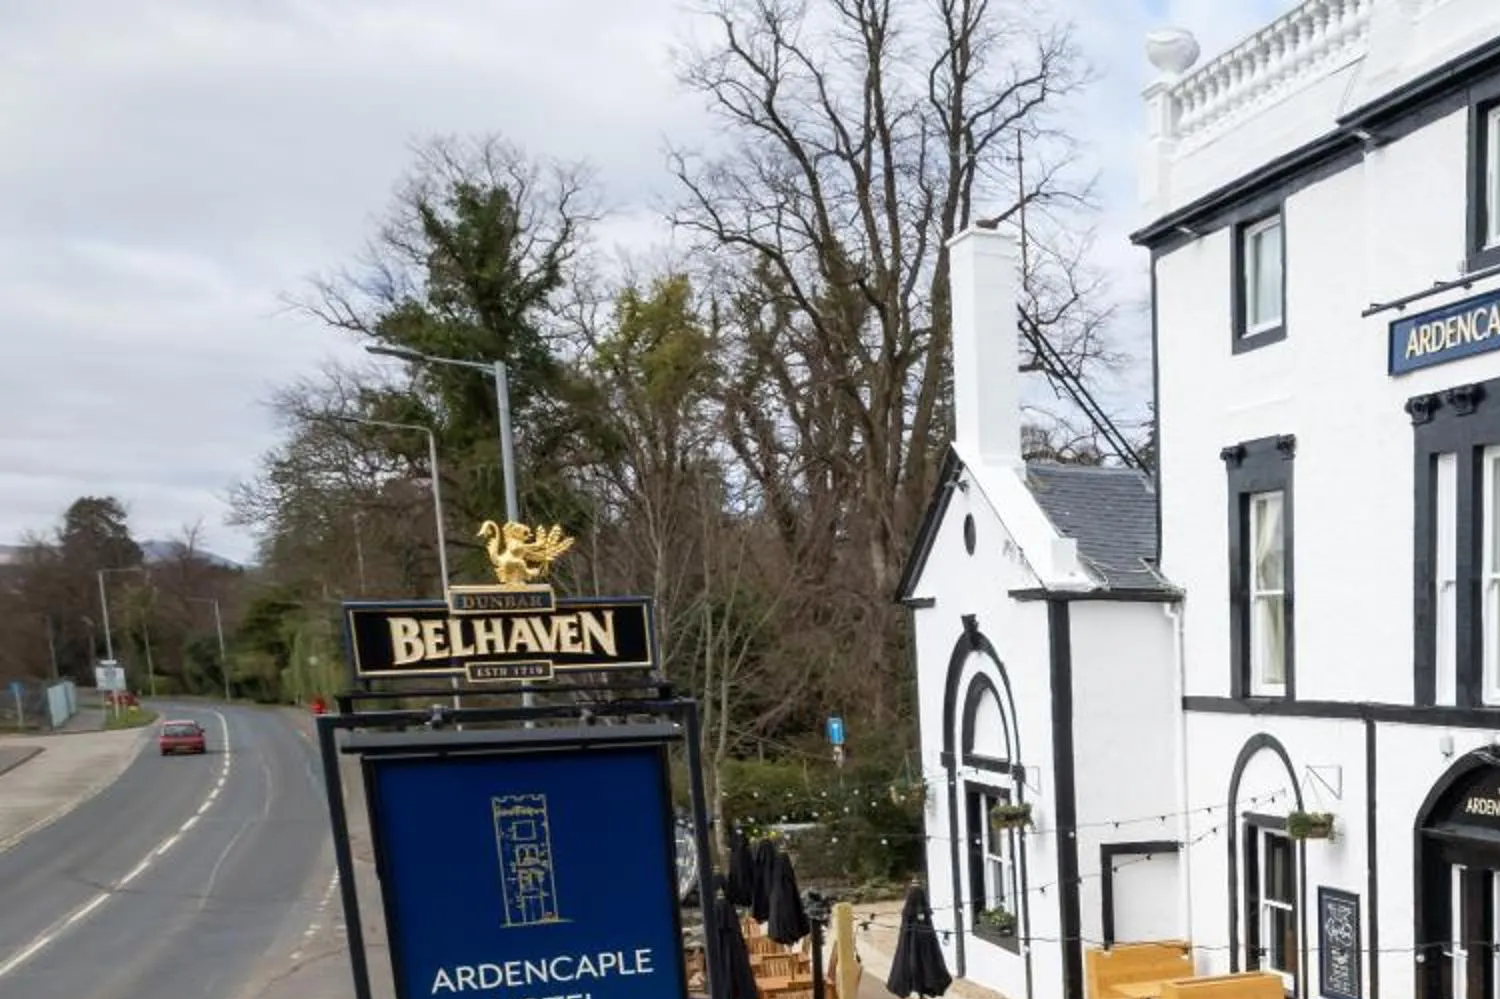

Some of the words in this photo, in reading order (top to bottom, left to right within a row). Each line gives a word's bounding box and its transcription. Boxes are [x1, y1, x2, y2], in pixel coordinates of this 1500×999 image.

[463, 595, 544, 609] DUNBAR
[386, 610, 618, 666] BELHAVEN
[431, 948, 655, 995] ARDENCAPLE
